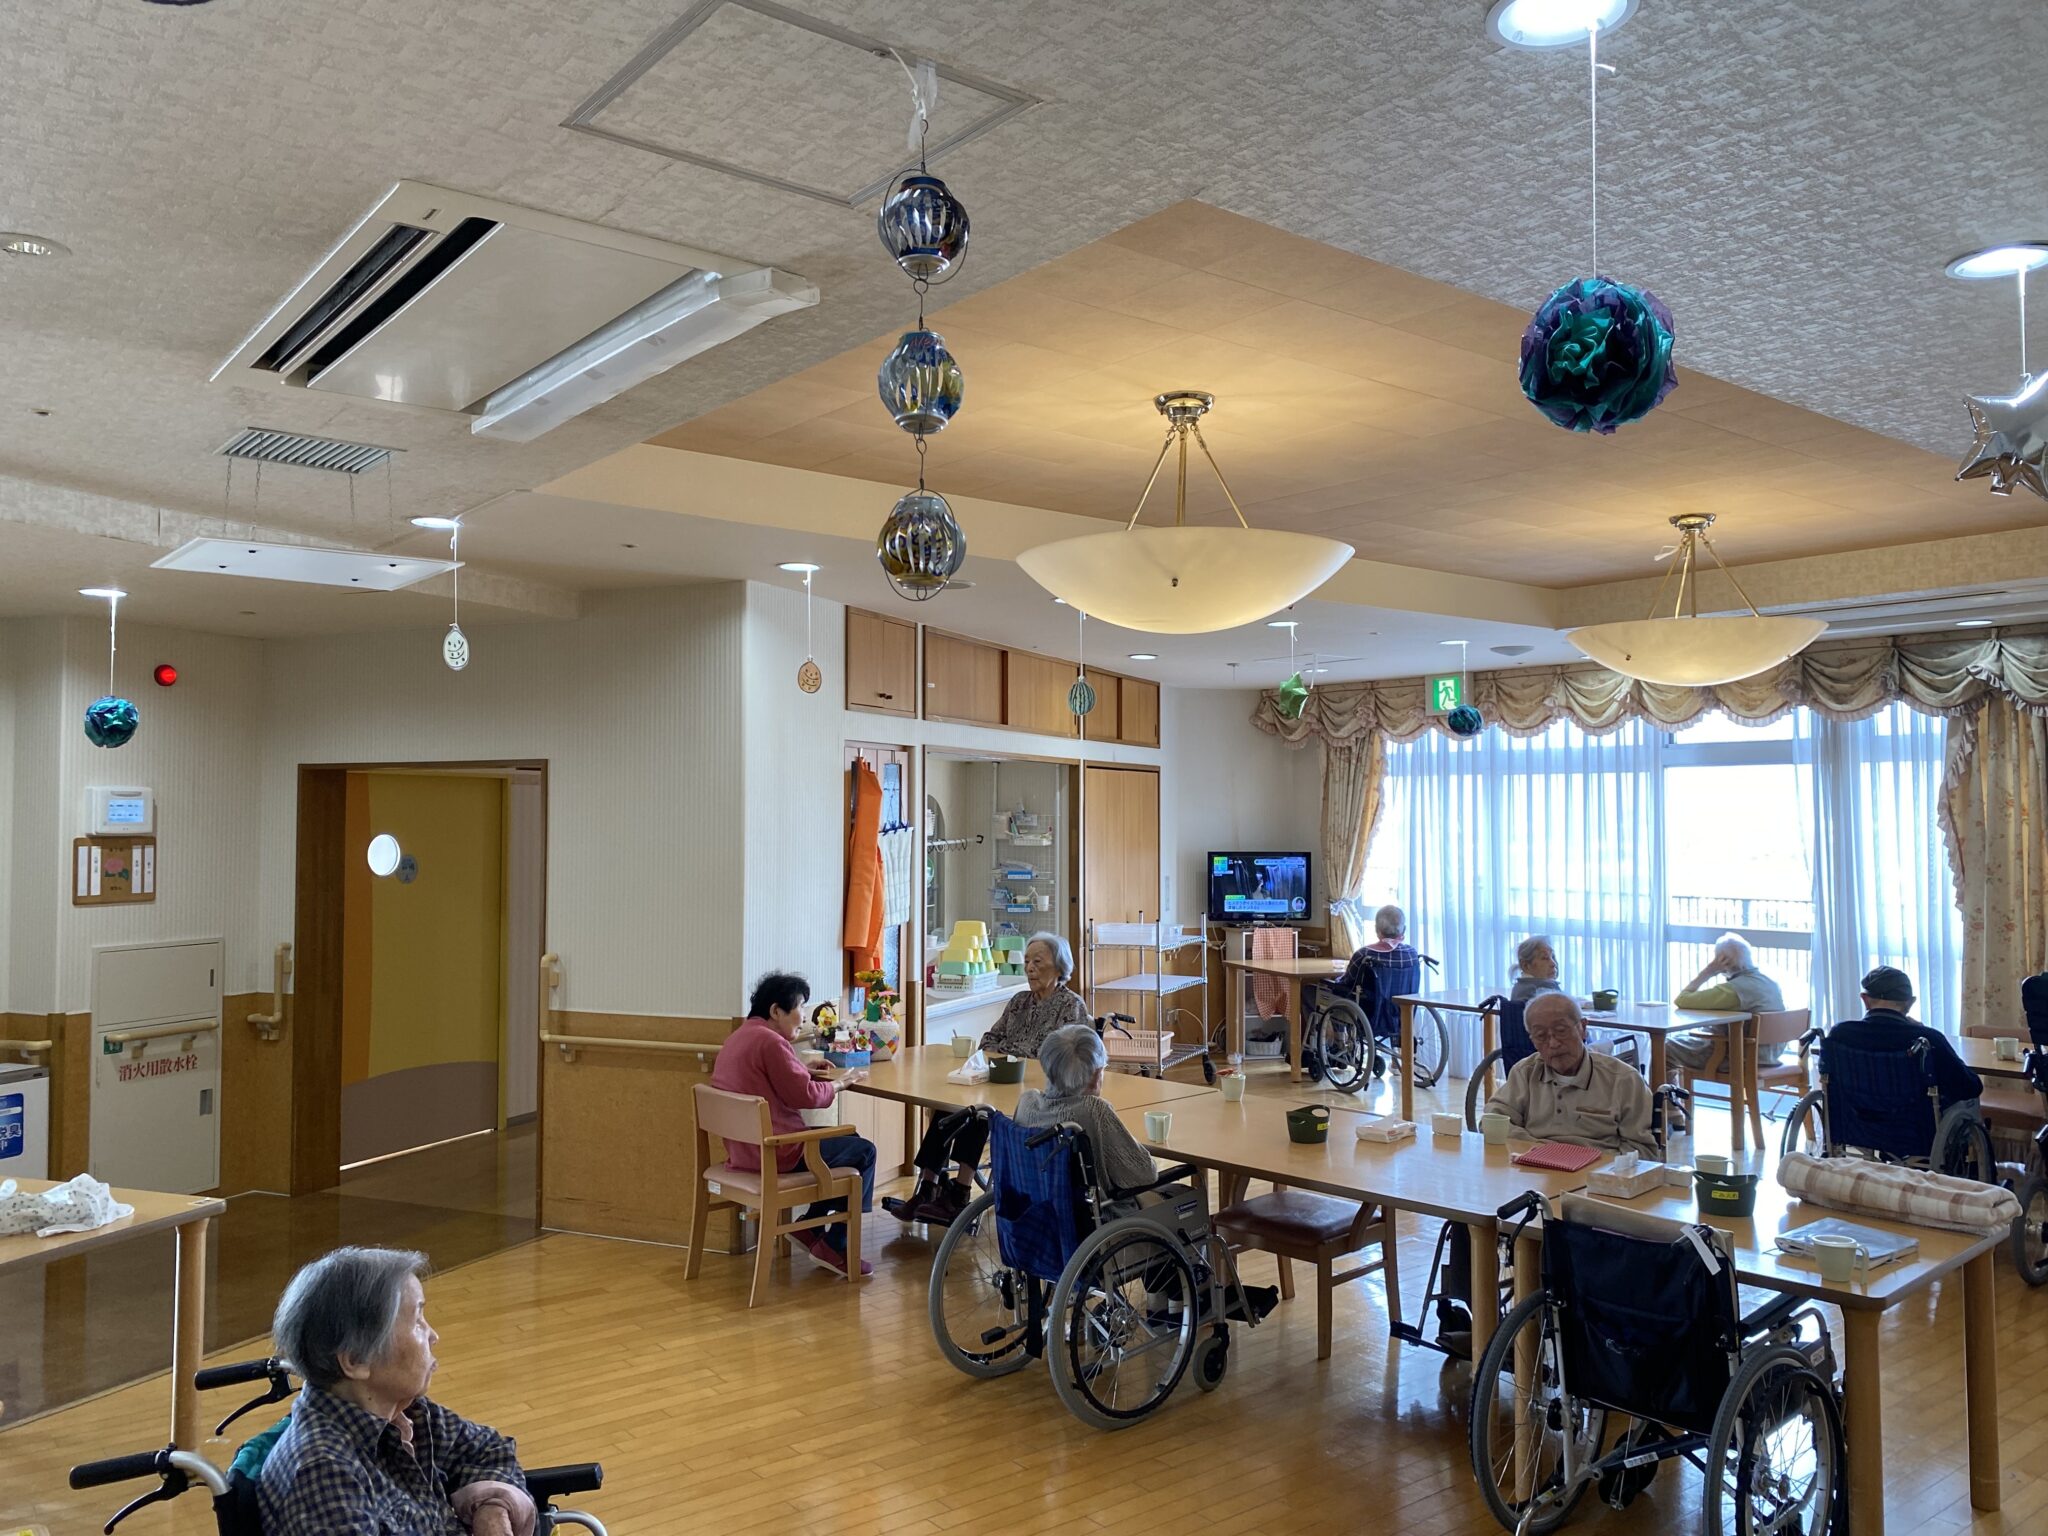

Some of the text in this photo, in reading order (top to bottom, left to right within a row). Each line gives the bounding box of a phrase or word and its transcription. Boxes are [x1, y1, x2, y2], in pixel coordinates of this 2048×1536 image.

[119, 1054, 198, 1082] 消火用散水栓
